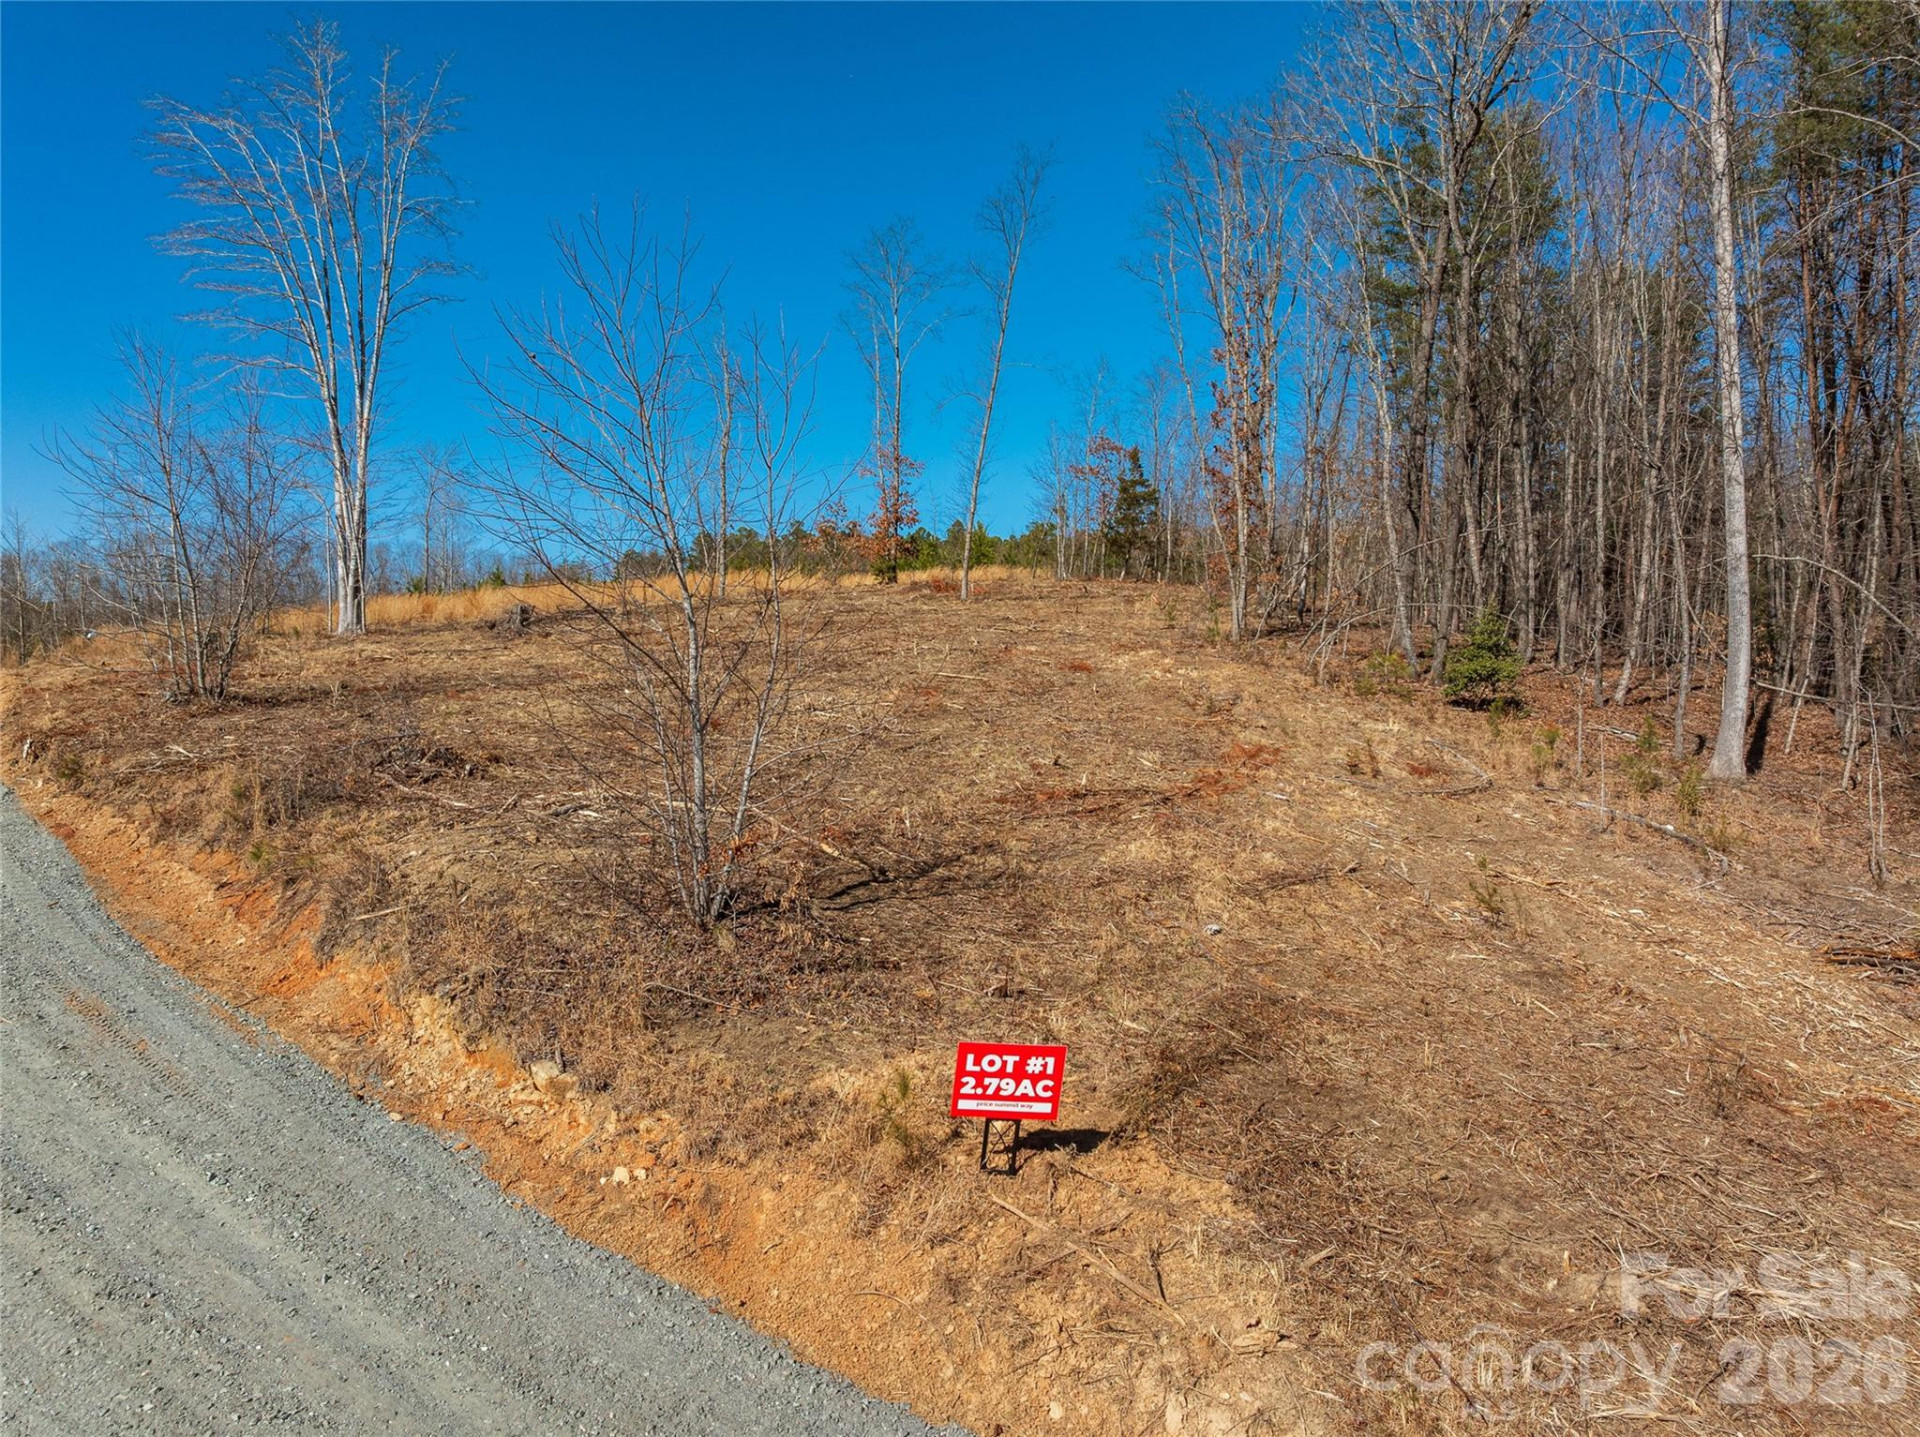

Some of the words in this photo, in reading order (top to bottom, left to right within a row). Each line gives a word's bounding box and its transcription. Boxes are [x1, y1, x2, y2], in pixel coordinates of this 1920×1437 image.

[965, 1053, 1020, 1073] LOT
[1025, 1056, 1056, 1075] #1
[960, 1076, 1055, 1098] 2.79AC
